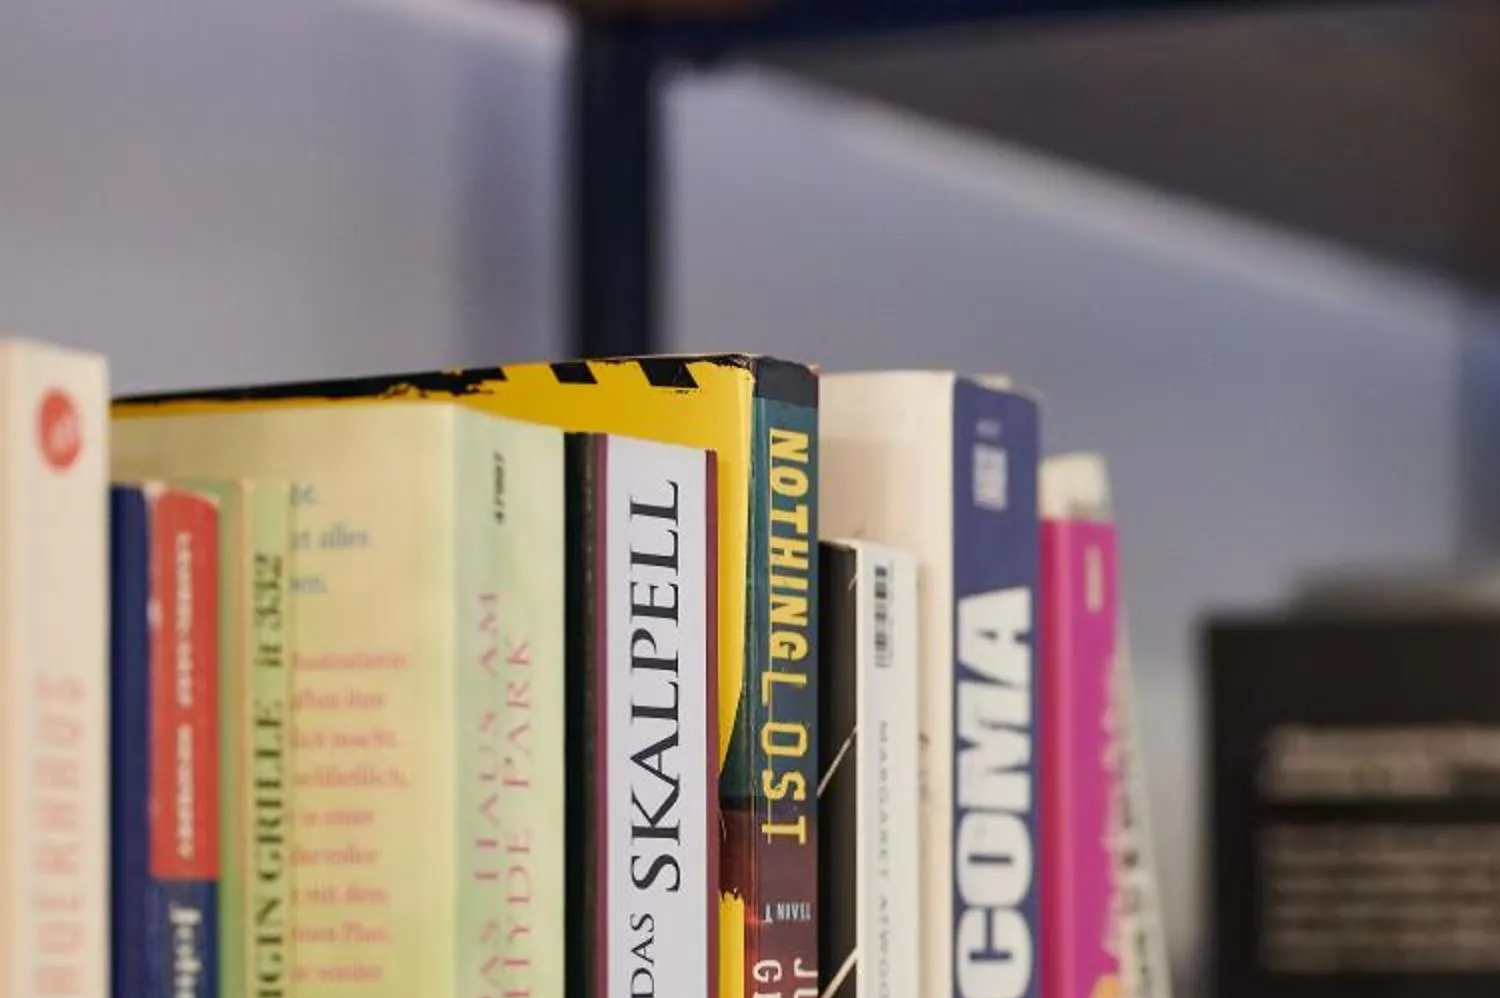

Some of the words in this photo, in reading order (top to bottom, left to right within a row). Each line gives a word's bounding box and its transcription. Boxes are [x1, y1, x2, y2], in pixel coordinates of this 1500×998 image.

[768, 428, 809, 662] NOTHING
[503, 632, 531, 790] PARK
[629, 479, 681, 893] SKALPELL
[760, 672, 808, 845] LOST
[254, 700, 286, 882] GRILLE
[878, 720, 890, 879] MARGARET
